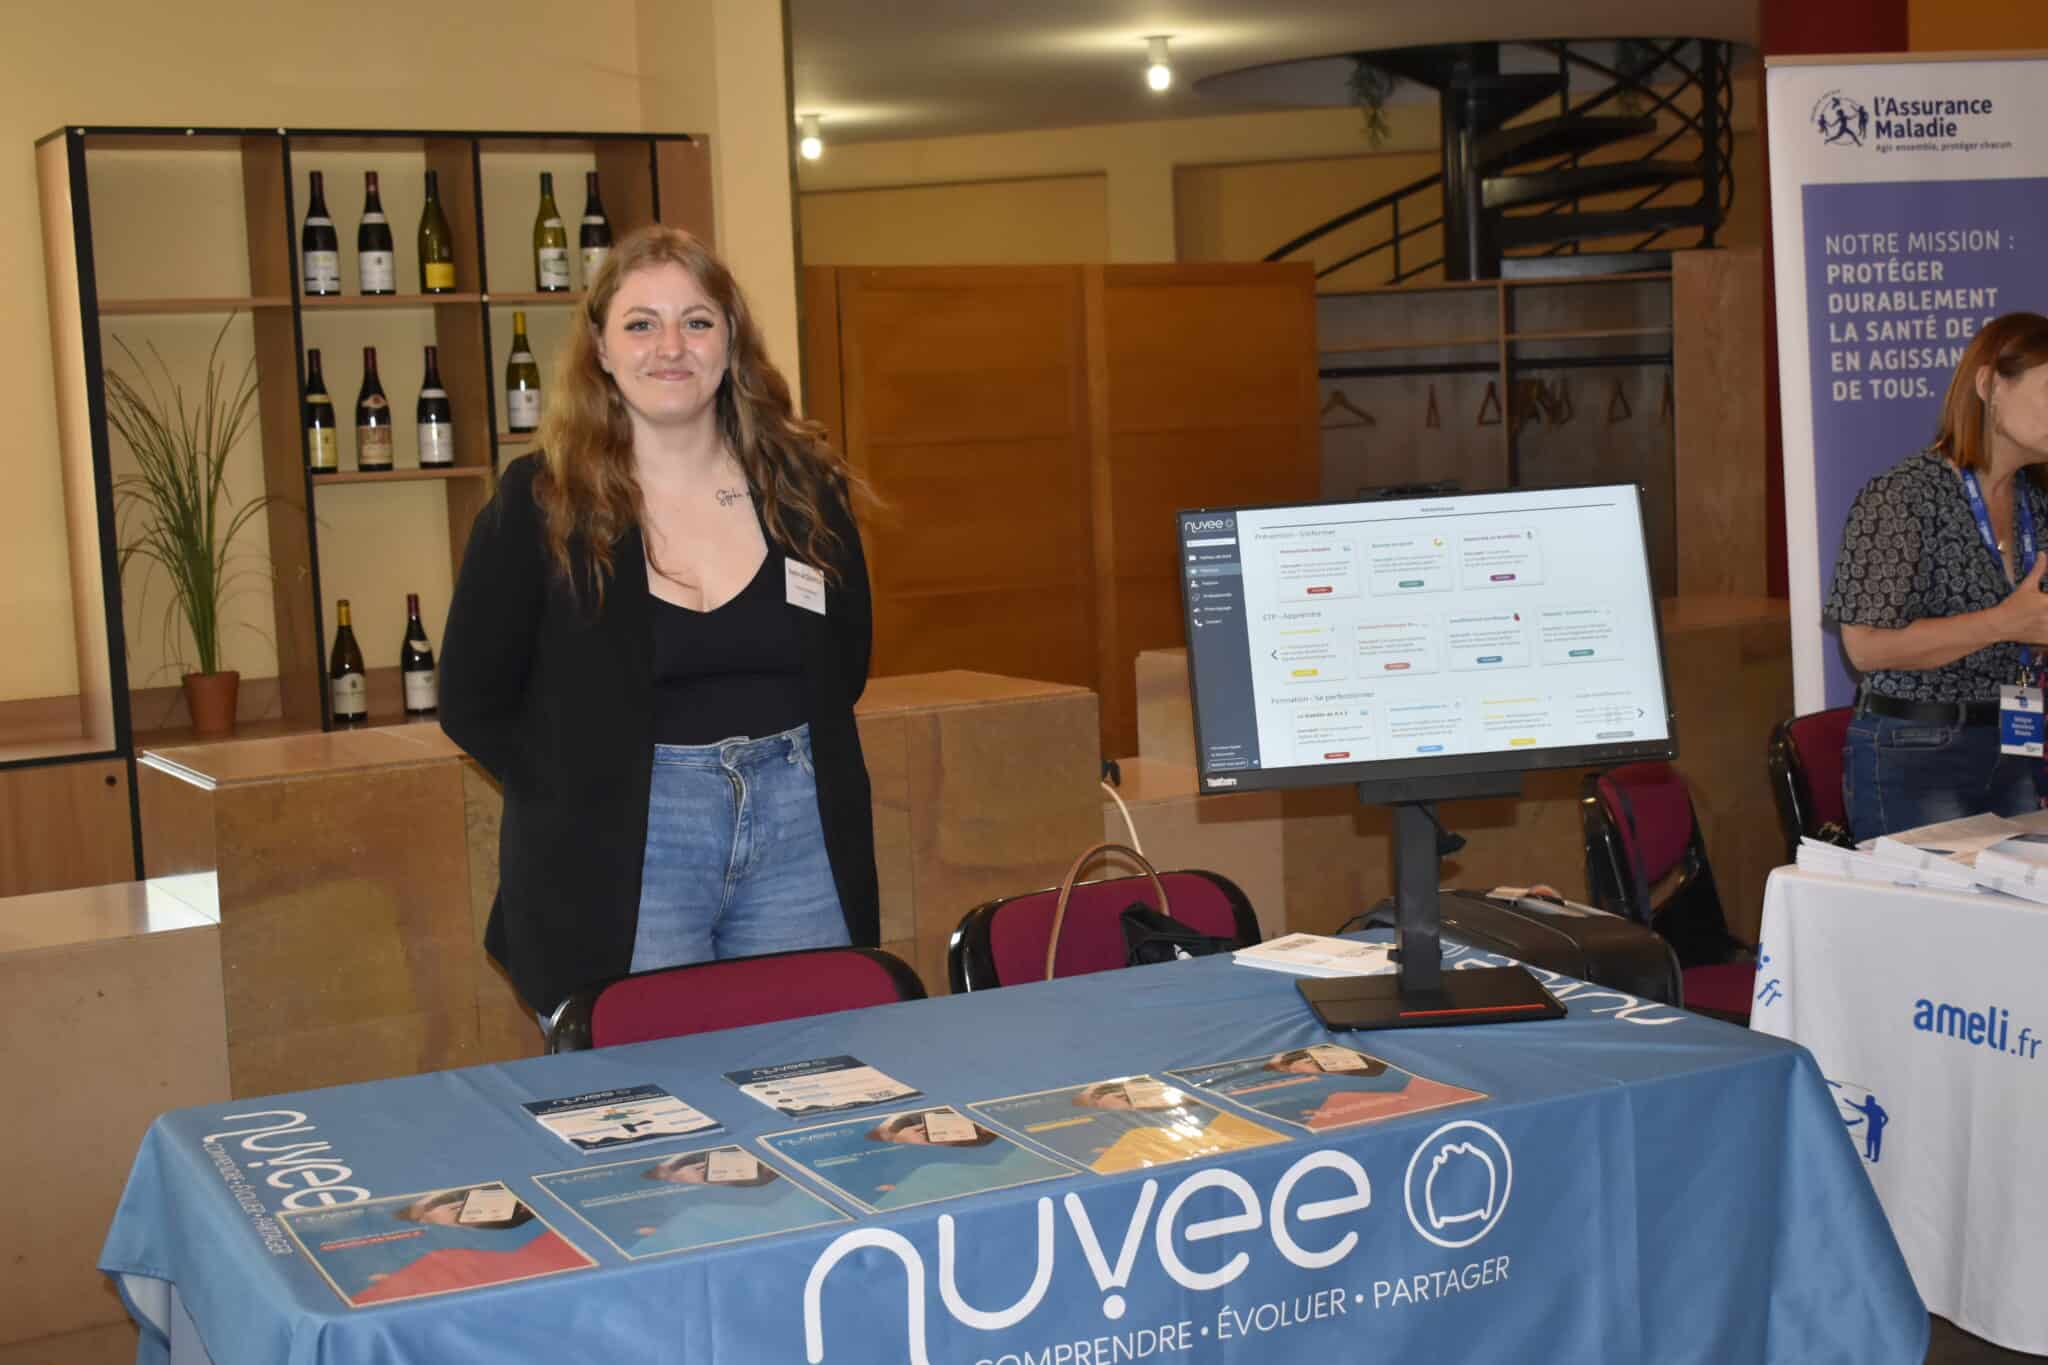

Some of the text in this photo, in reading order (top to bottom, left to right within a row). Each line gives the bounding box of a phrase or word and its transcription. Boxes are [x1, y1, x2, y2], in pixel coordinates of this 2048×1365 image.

[1873, 96, 1993, 117] l'Assurance
[1875, 117, 1957, 139] Maladie
[1825, 232, 1899, 255] NOTRE
[1908, 229, 2000, 253] MISSION
[1827, 257, 1944, 285] PROTÉGER
[1828, 287, 1998, 314] DURABLEMENT
[1830, 322, 1860, 343] LA
[1866, 314, 1937, 342] SANTÉ
[1945, 317, 1974, 339] DE
[1831, 351, 1861, 373] EN
[1833, 377, 1936, 401] DE TOUS.
[1185, 519, 1224, 534] nuvee
[1913, 998, 2043, 1060] ameli.fr
[803, 1149, 1371, 1365] nuvee
[1217, 1286, 1347, 1340] ÉVOLUER
[1374, 1255, 1511, 1309] PARTAGER
